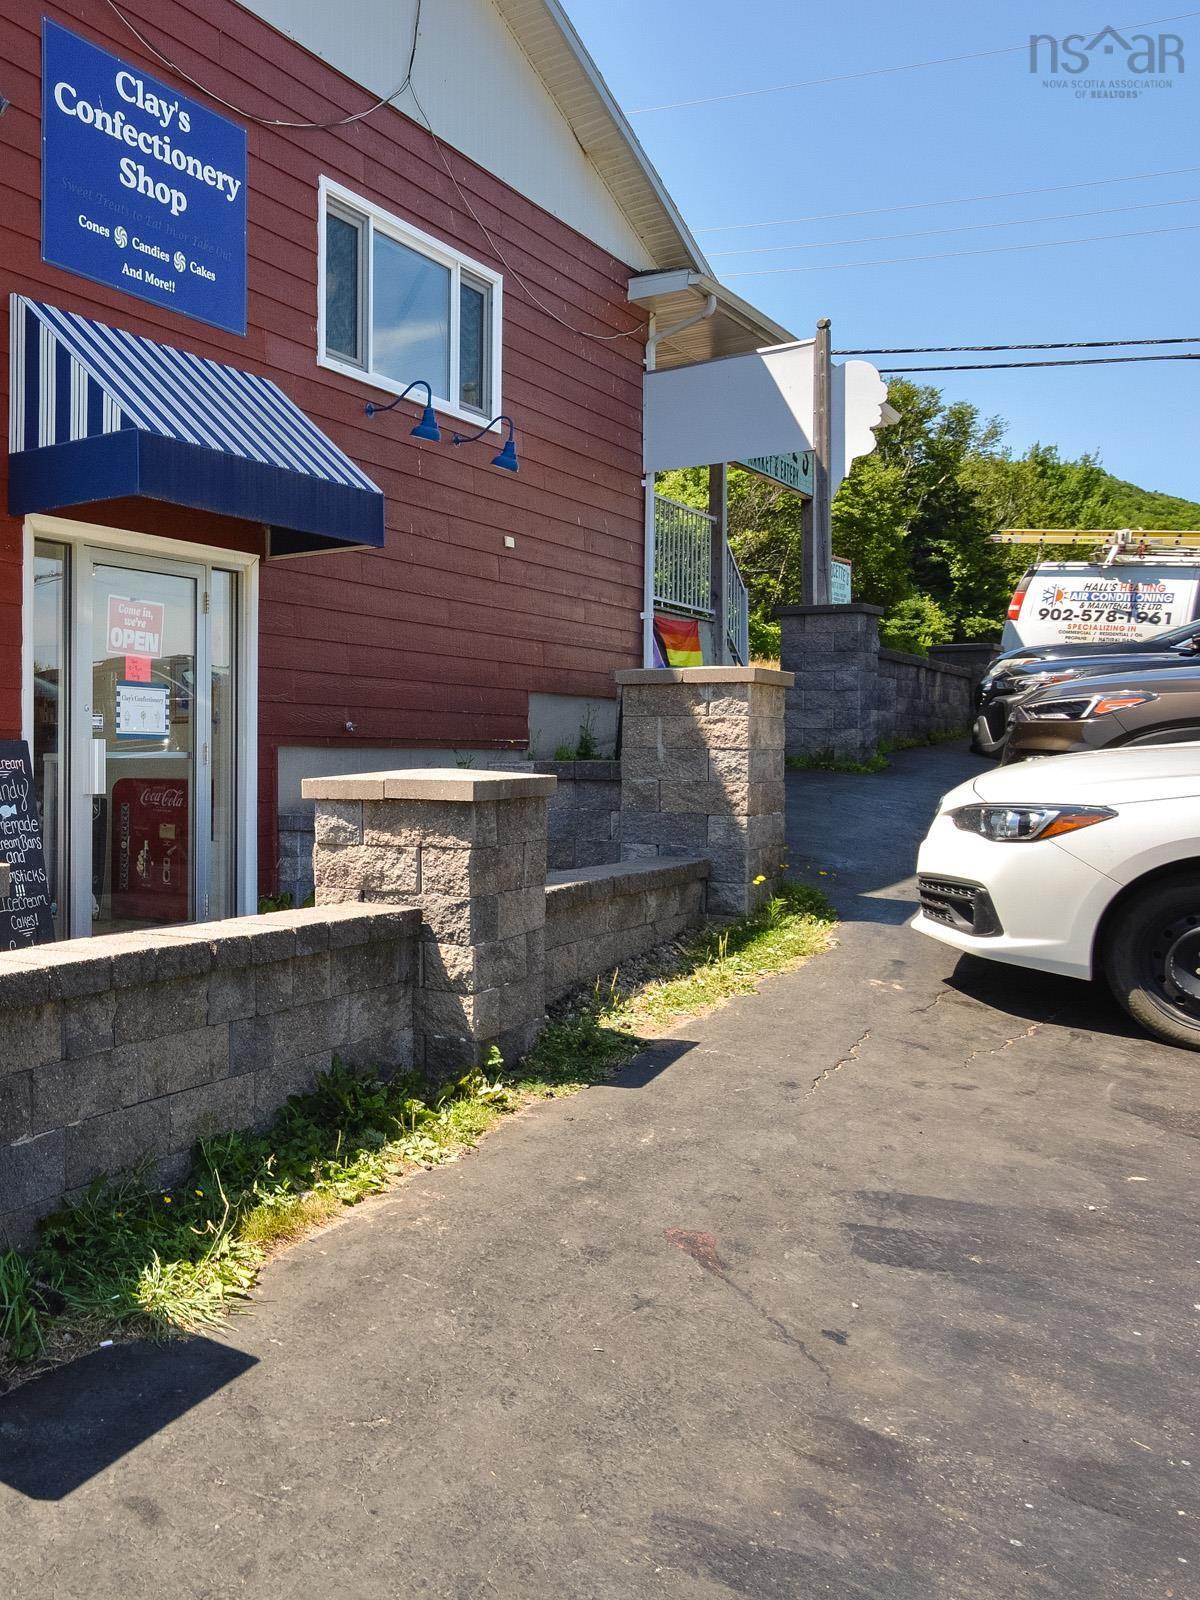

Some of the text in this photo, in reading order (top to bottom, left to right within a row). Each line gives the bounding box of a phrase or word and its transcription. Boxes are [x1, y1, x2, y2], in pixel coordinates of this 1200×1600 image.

[115, 71, 191, 133] Clay's
[54, 82, 241, 202] Confectionery
[119, 157, 188, 216] Shop
[78, 214, 217, 282] Cones Candies Cakes
[121, 262, 176, 293] And More!!
[1084, 582, 1167, 593] HALL'S HEATING
[1070, 592, 1174, 603] AIR CONDITIONING
[118, 603, 141, 616] Come
[1087, 602, 1146, 611] MAINTENANCE
[124, 617, 147, 628] we're
[1038, 608, 1173, 625] 902-578-1961
[1067, 623, 1126, 632] SPECIALIZING
[110, 627, 160, 652] OPEN
[19, 834, 42, 852] Bars
[6, 851, 26, 864] and
[10, 912, 39, 930] Cakes!
